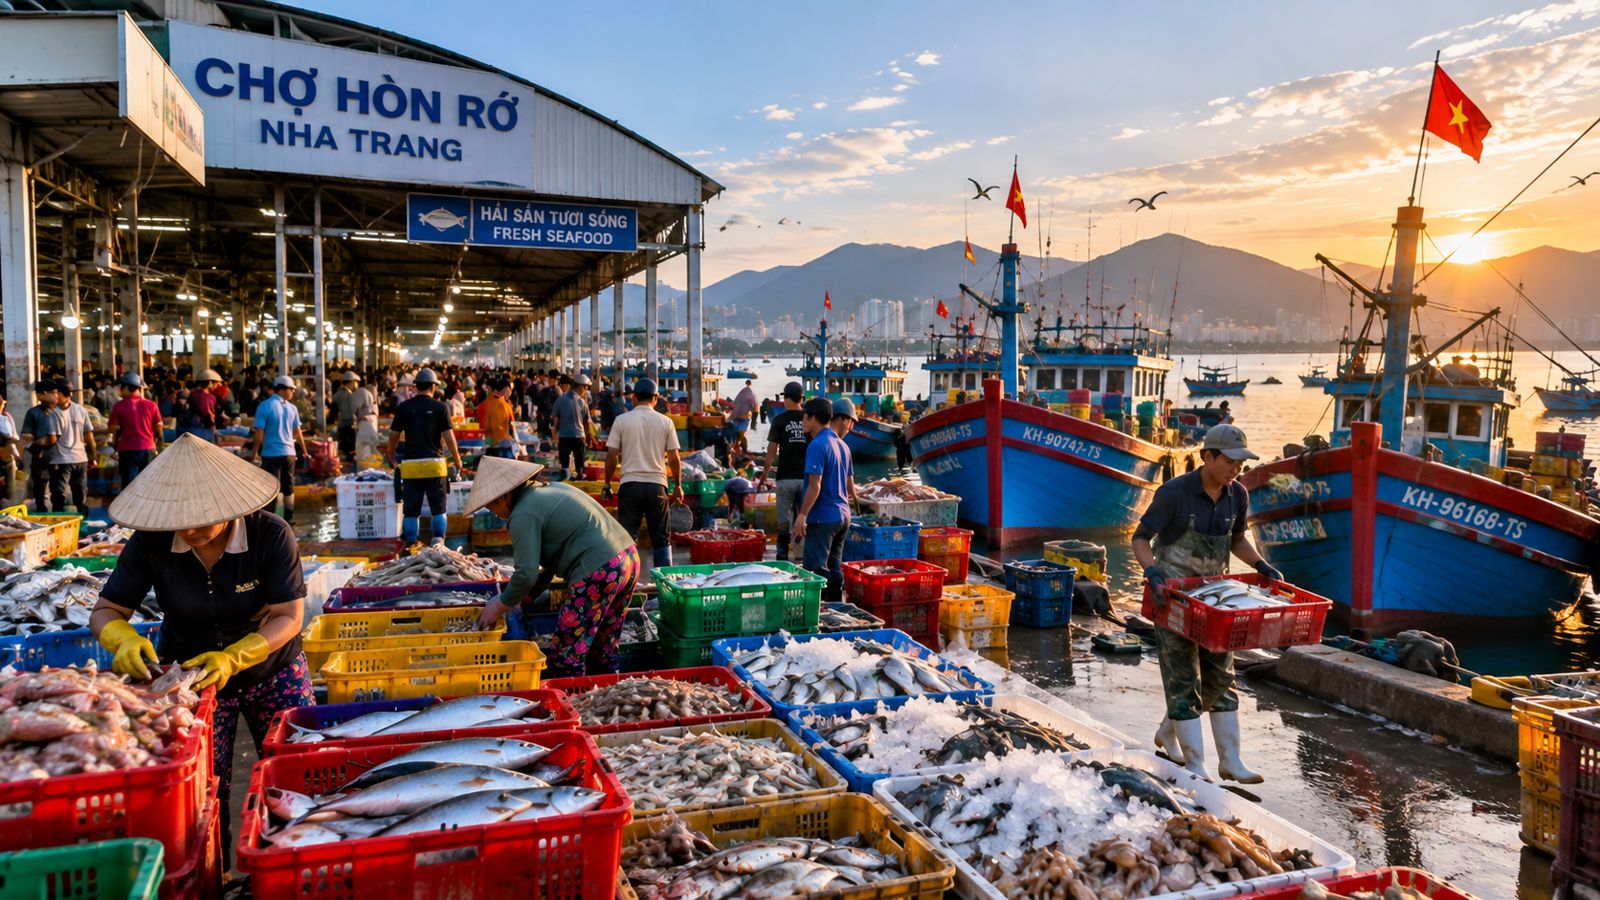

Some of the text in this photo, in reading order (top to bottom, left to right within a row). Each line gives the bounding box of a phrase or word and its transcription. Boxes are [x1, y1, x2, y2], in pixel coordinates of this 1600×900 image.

[194, 57, 520, 133] CHỢ HÒN RỚ
[260, 118, 463, 162] NHA TRANG
[493, 226, 613, 246] FRESH SEAFOOD
[1401, 485, 1528, 540] KH-96168-TS
